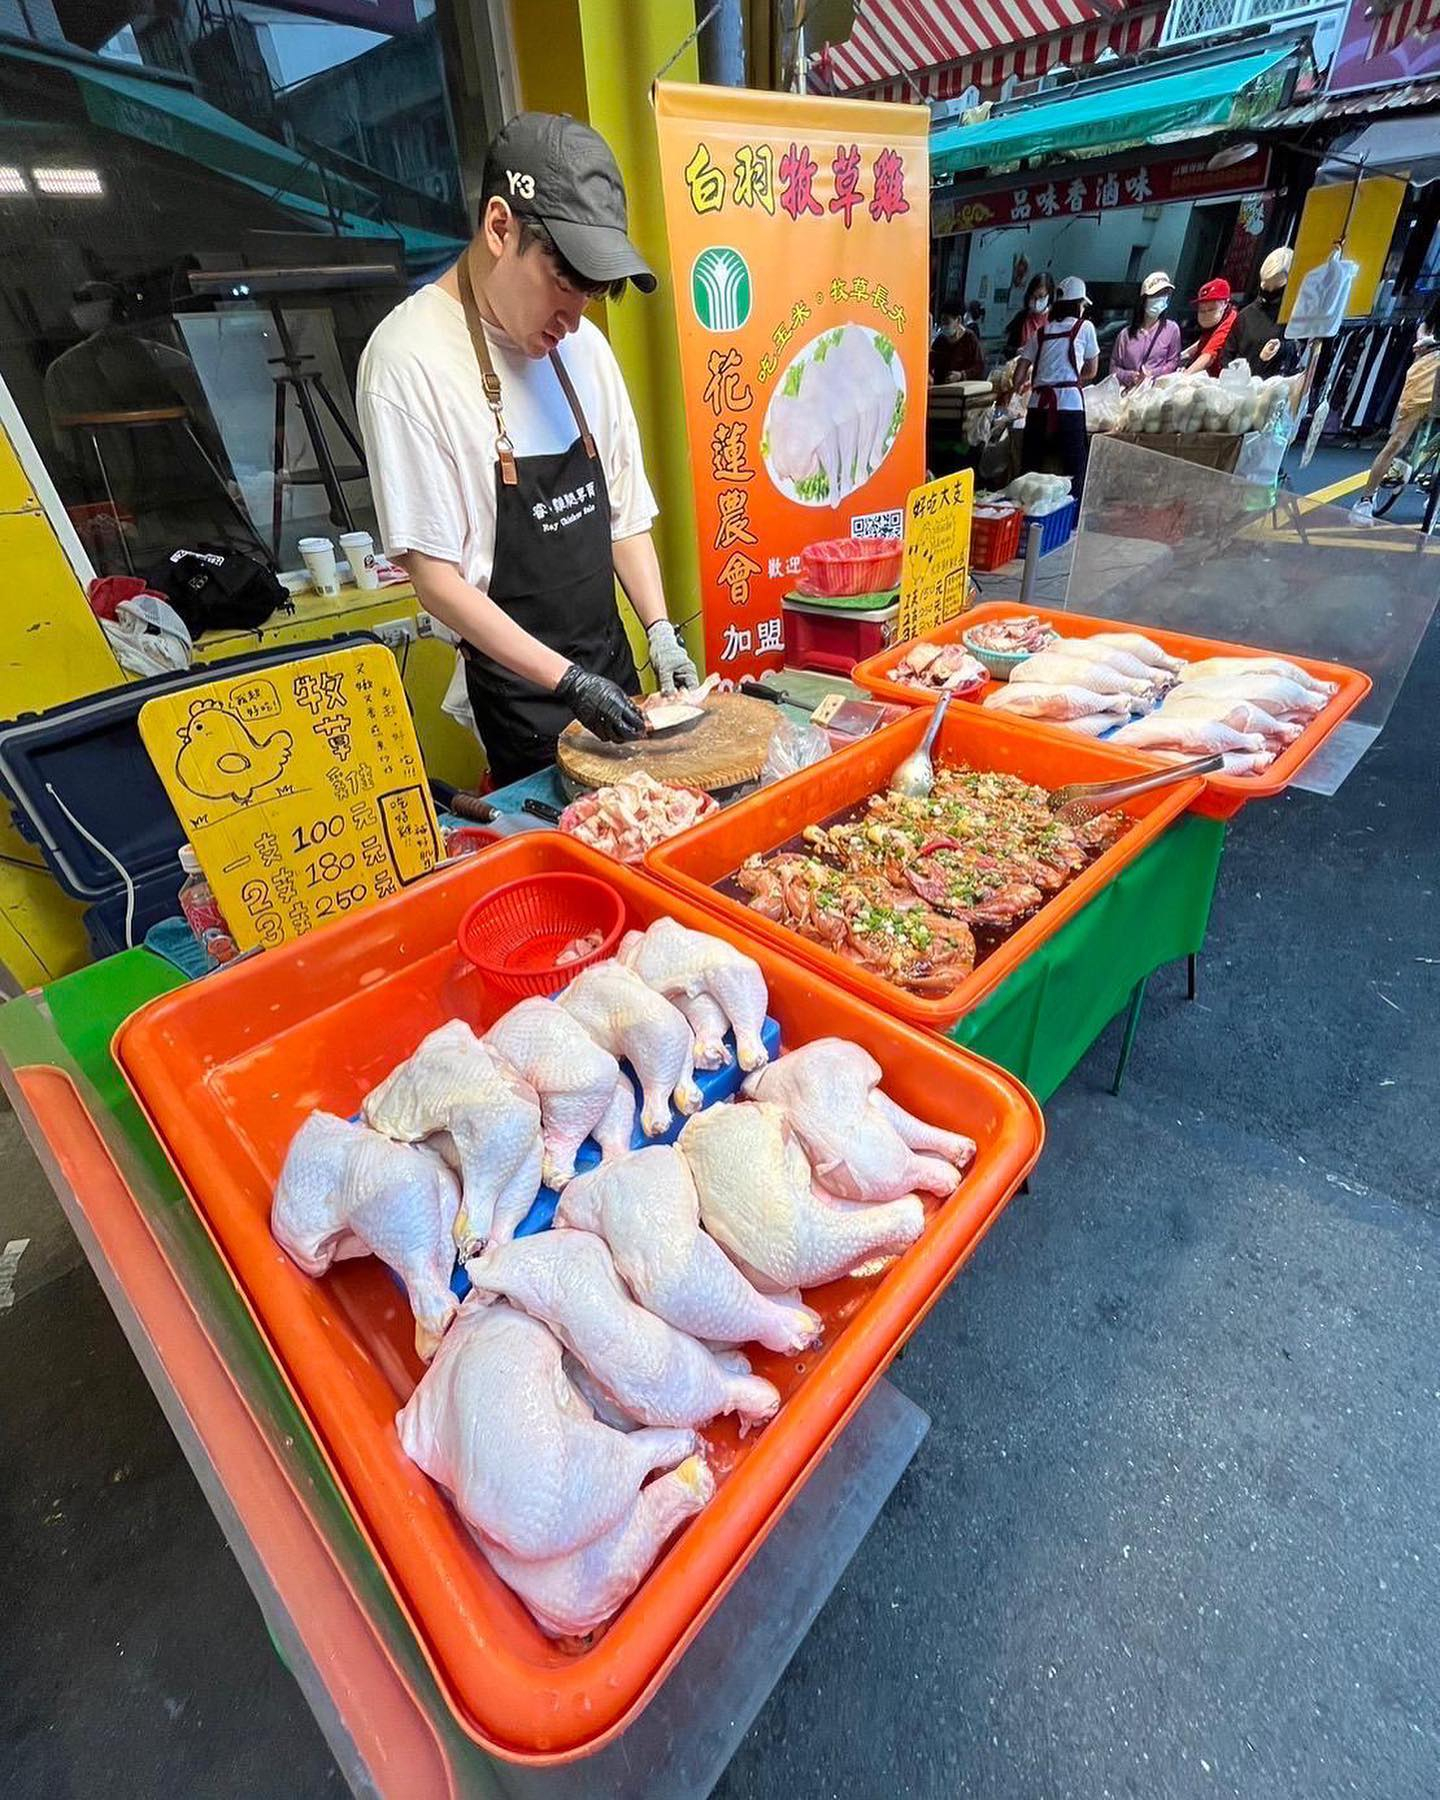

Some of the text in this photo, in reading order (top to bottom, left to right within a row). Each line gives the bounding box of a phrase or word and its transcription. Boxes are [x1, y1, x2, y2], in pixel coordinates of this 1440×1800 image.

[685, 143, 910, 229] 白羽牧草雞
[1008, 165, 1153, 221] 品味香滷味
[702, 347, 762, 606] 花蓮農會
[913, 480, 964, 519] 好吃大支
[767, 556, 802, 579] 歡迎
[720, 617, 786, 662] 加盟
